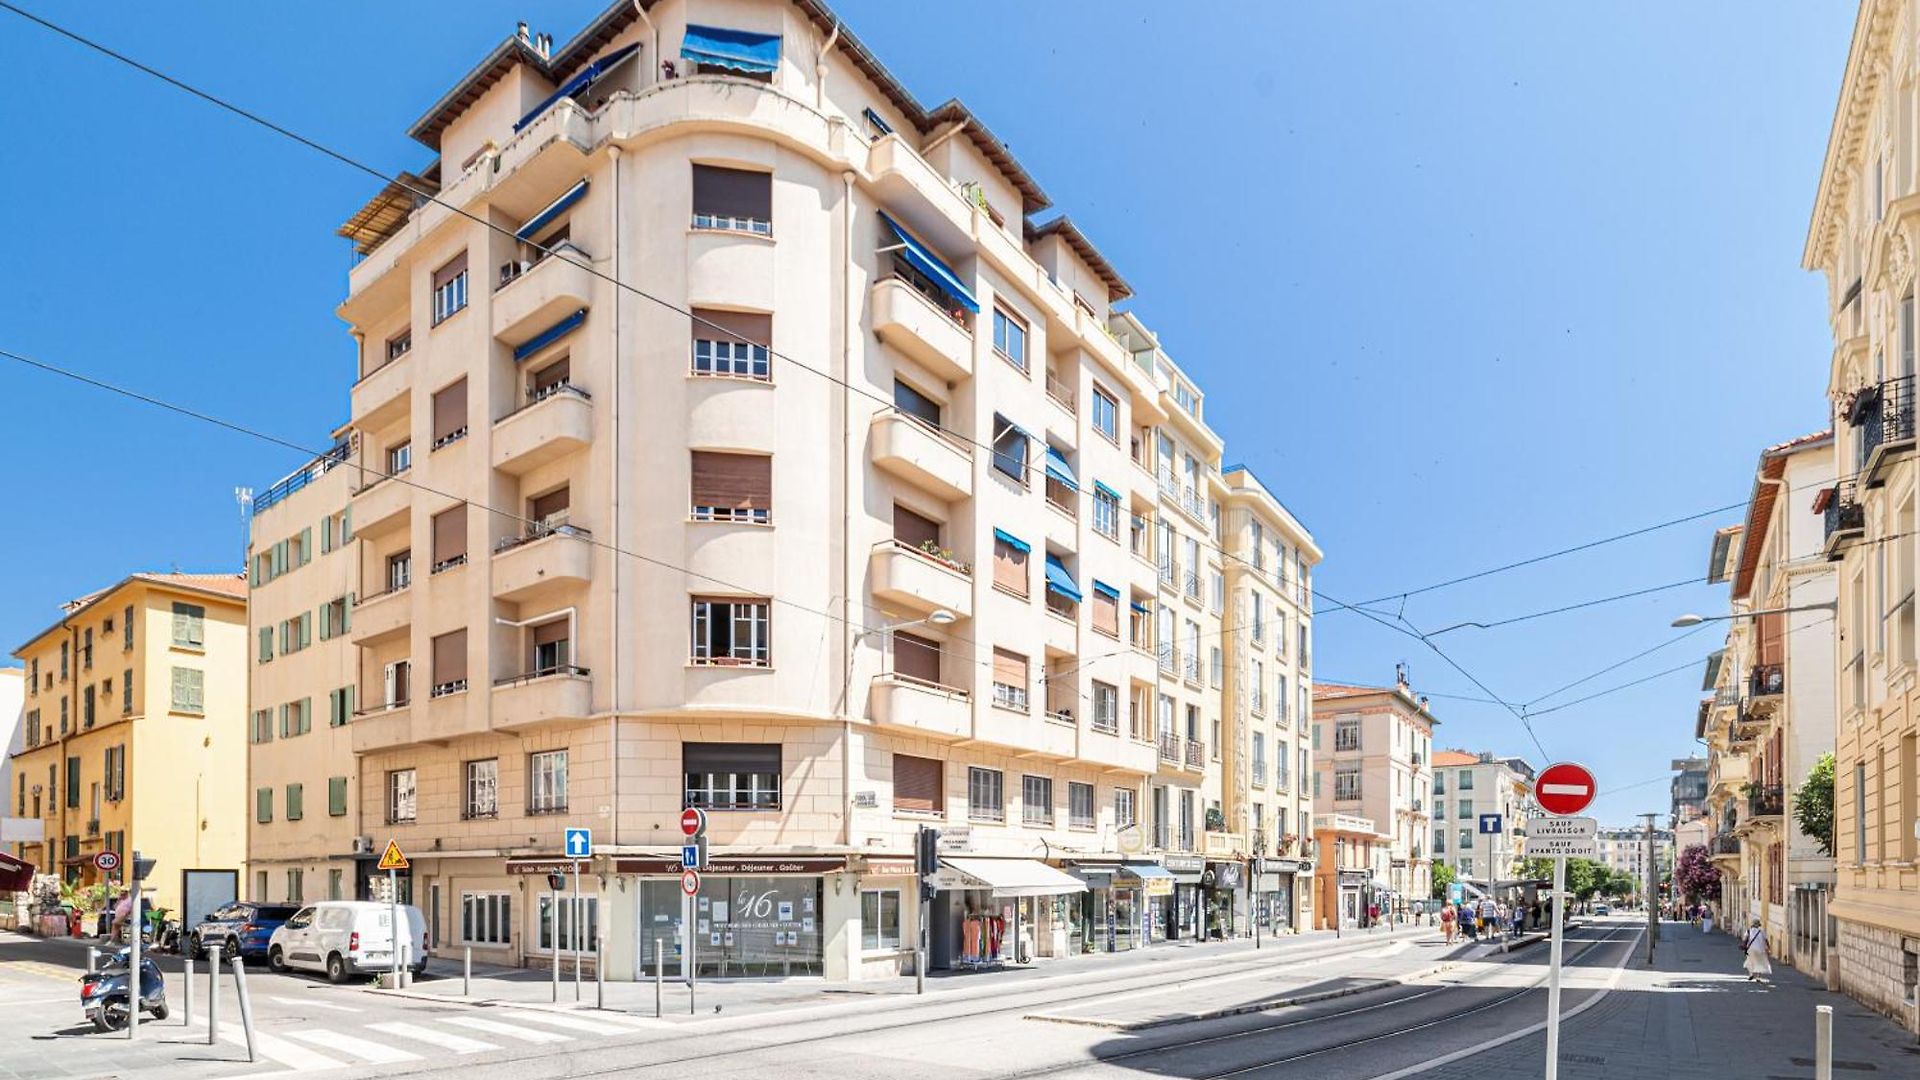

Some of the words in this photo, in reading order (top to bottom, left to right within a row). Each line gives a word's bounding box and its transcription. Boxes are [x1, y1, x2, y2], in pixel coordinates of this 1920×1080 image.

[1483, 817, 1497, 832] T
[100, 857, 115, 865] 30
[738, 889, 779, 918] 16
